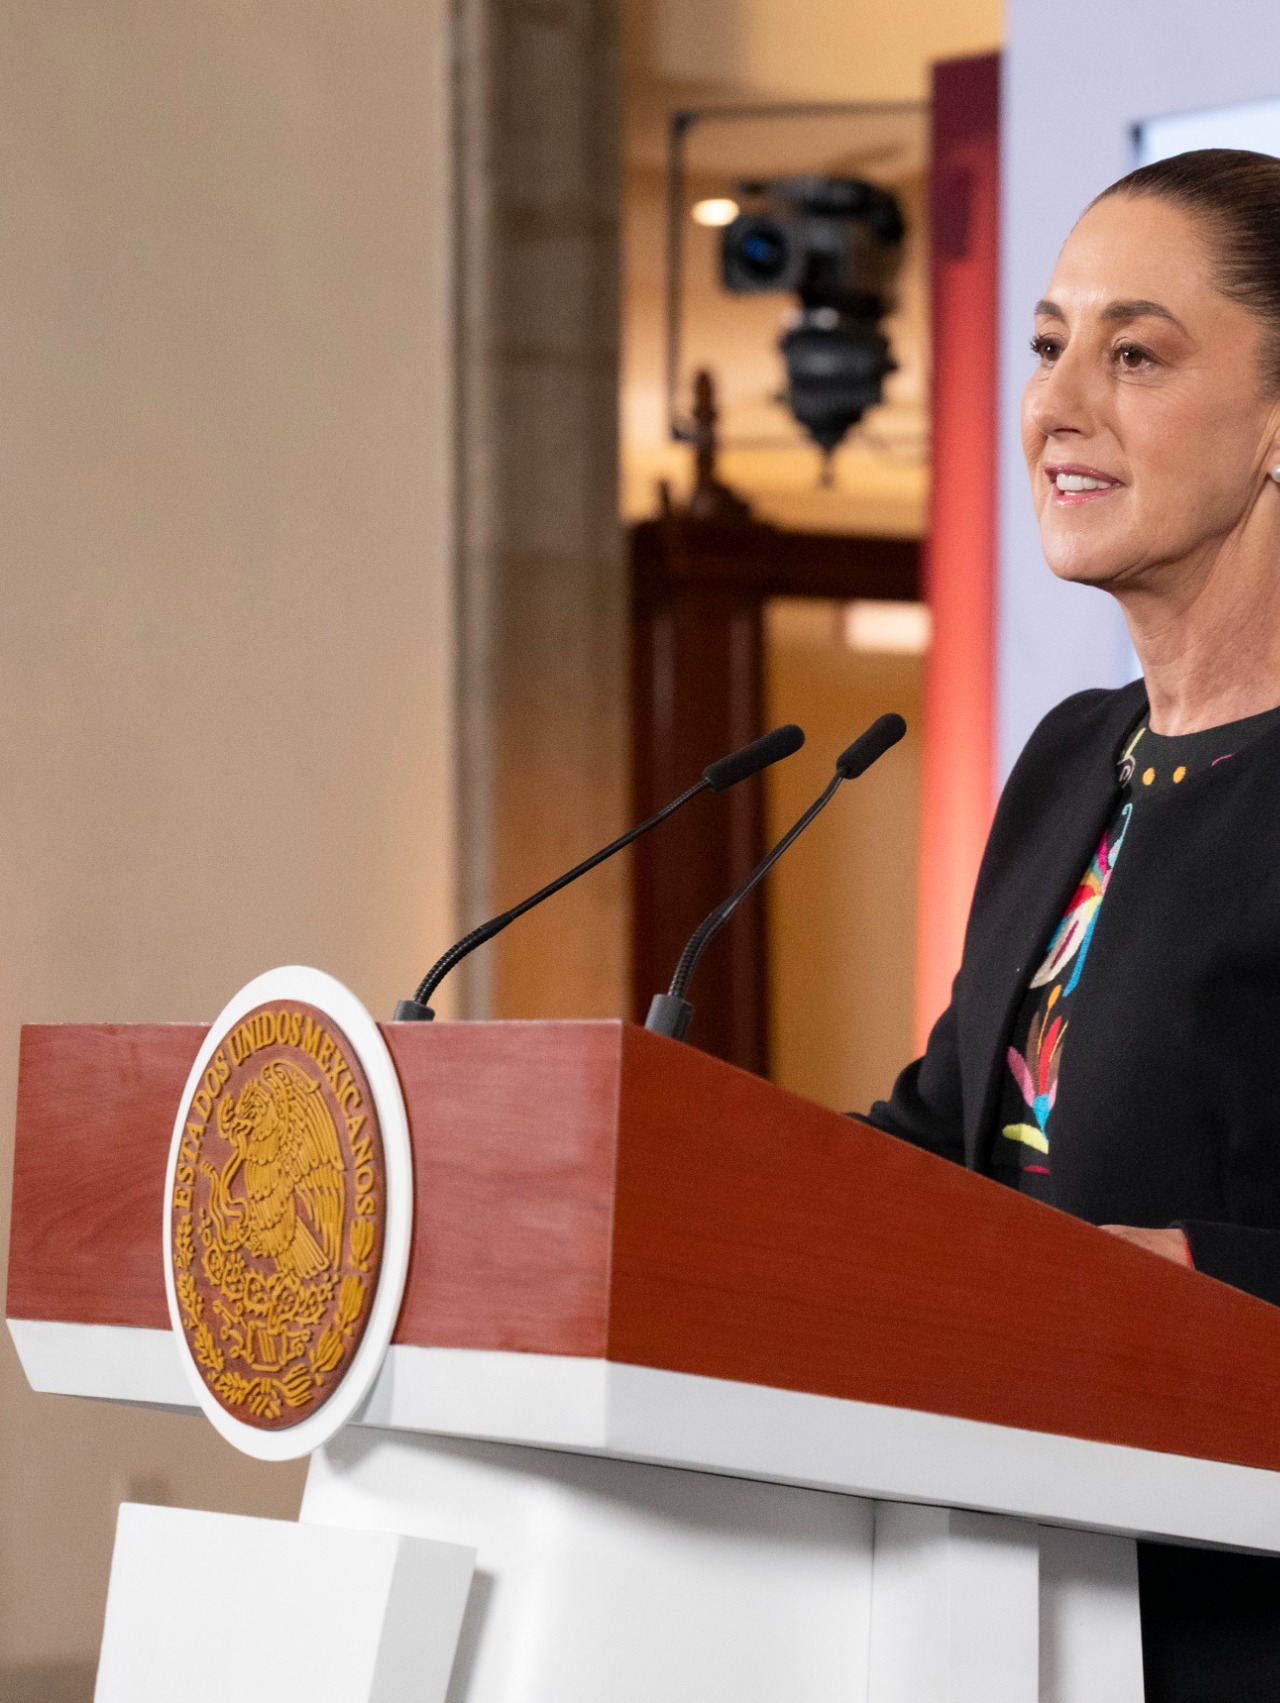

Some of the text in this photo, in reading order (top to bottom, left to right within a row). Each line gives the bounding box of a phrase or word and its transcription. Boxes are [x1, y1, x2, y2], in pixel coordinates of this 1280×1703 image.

[174, 1010, 376, 1216] ESTADOS UNIDOS MEXICANOS
